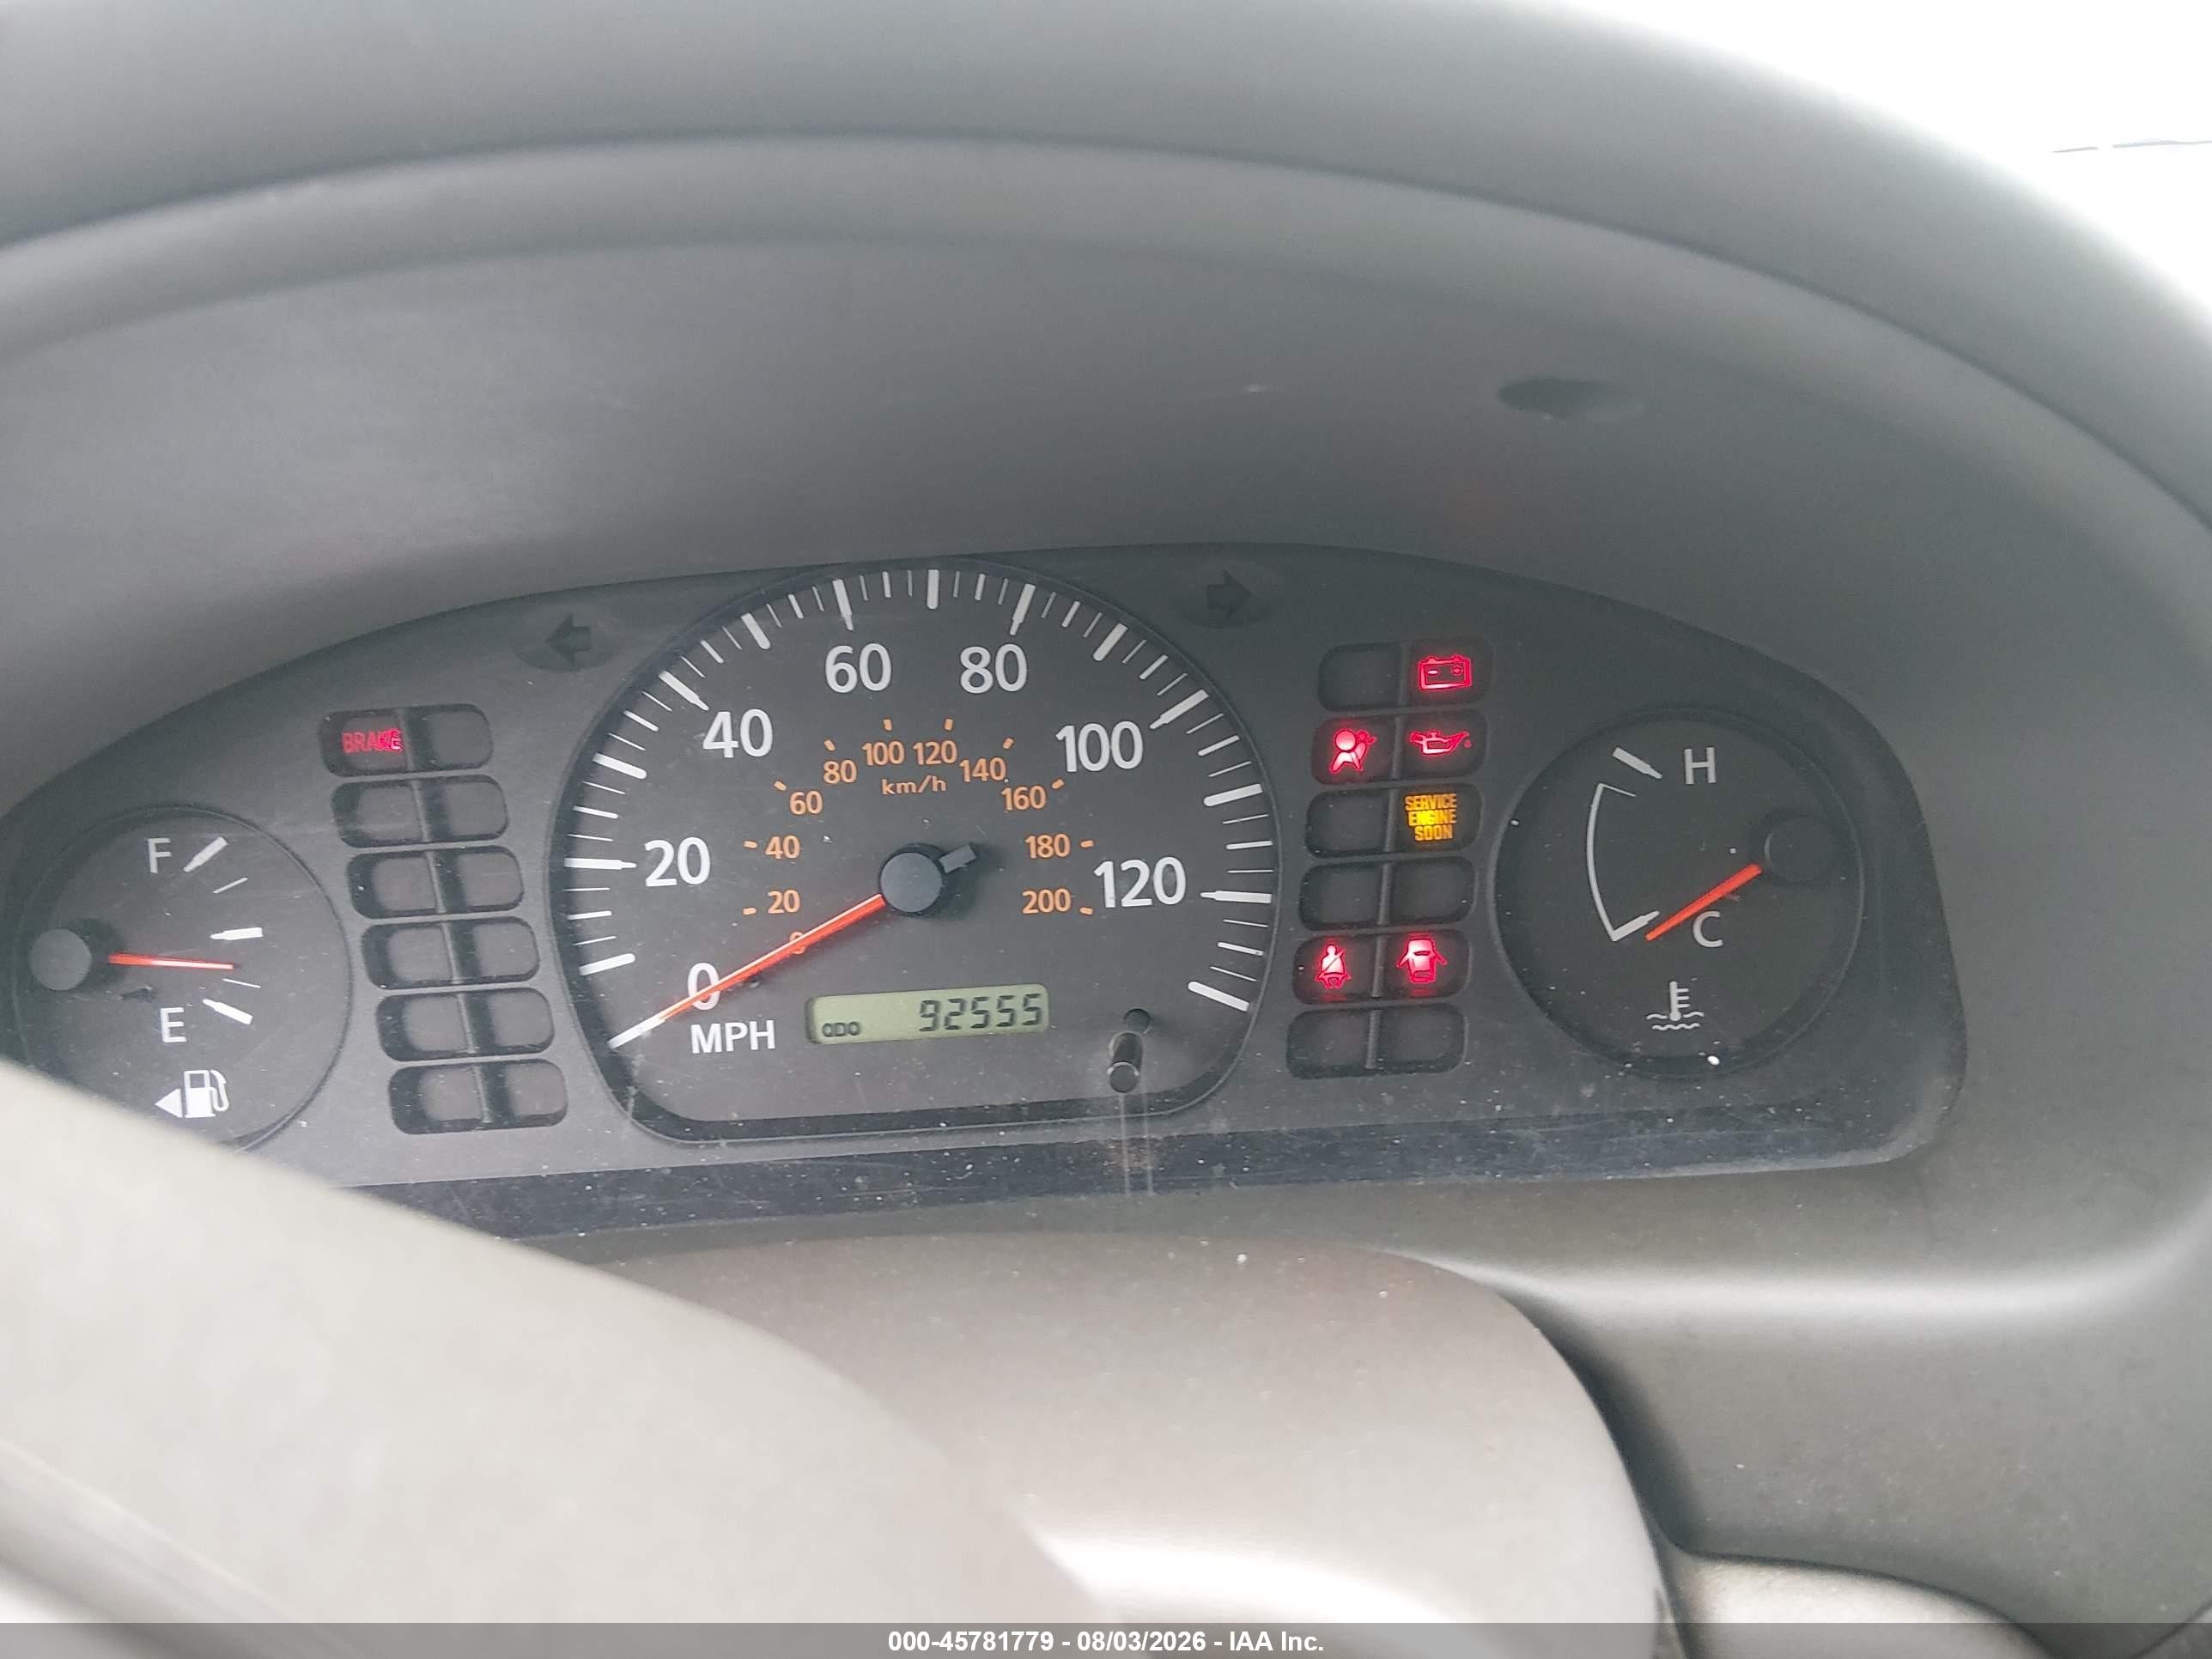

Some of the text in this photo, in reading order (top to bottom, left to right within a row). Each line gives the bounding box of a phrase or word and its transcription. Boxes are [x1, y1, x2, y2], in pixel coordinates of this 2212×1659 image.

[824, 642, 892, 694] 60
[959, 643, 1028, 694] 80
[343, 728, 403, 754] BRAKE
[702, 708, 773, 758] 40
[862, 740, 904, 766] 100
[913, 739, 958, 765] 120
[1055, 720, 1144, 773] 100
[823, 759, 857, 784] 80
[959, 757, 1006, 782] 140
[1683, 746, 1717, 785] H
[881, 775, 947, 796] km/h
[1001, 786, 1047, 811] 160
[789, 790, 823, 815] 60
[1405, 793, 1457, 811] SERVICE
[1408, 811, 1457, 826] ENGINE
[764, 835, 800, 859] 40
[1024, 833, 1071, 859] 180
[1414, 826, 1453, 842] SOON
[147, 837, 172, 874] F
[644, 836, 711, 887] 20
[1093, 856, 1187, 908] 120
[768, 889, 800, 914] 20
[1022, 888, 1072, 915] 200
[1692, 910, 1723, 947] C
[687, 963, 720, 1011] 0
[161, 1007, 186, 1042] E
[822, 993, 1043, 1038] ODO 92555
[690, 1019, 776, 1054] MPH
